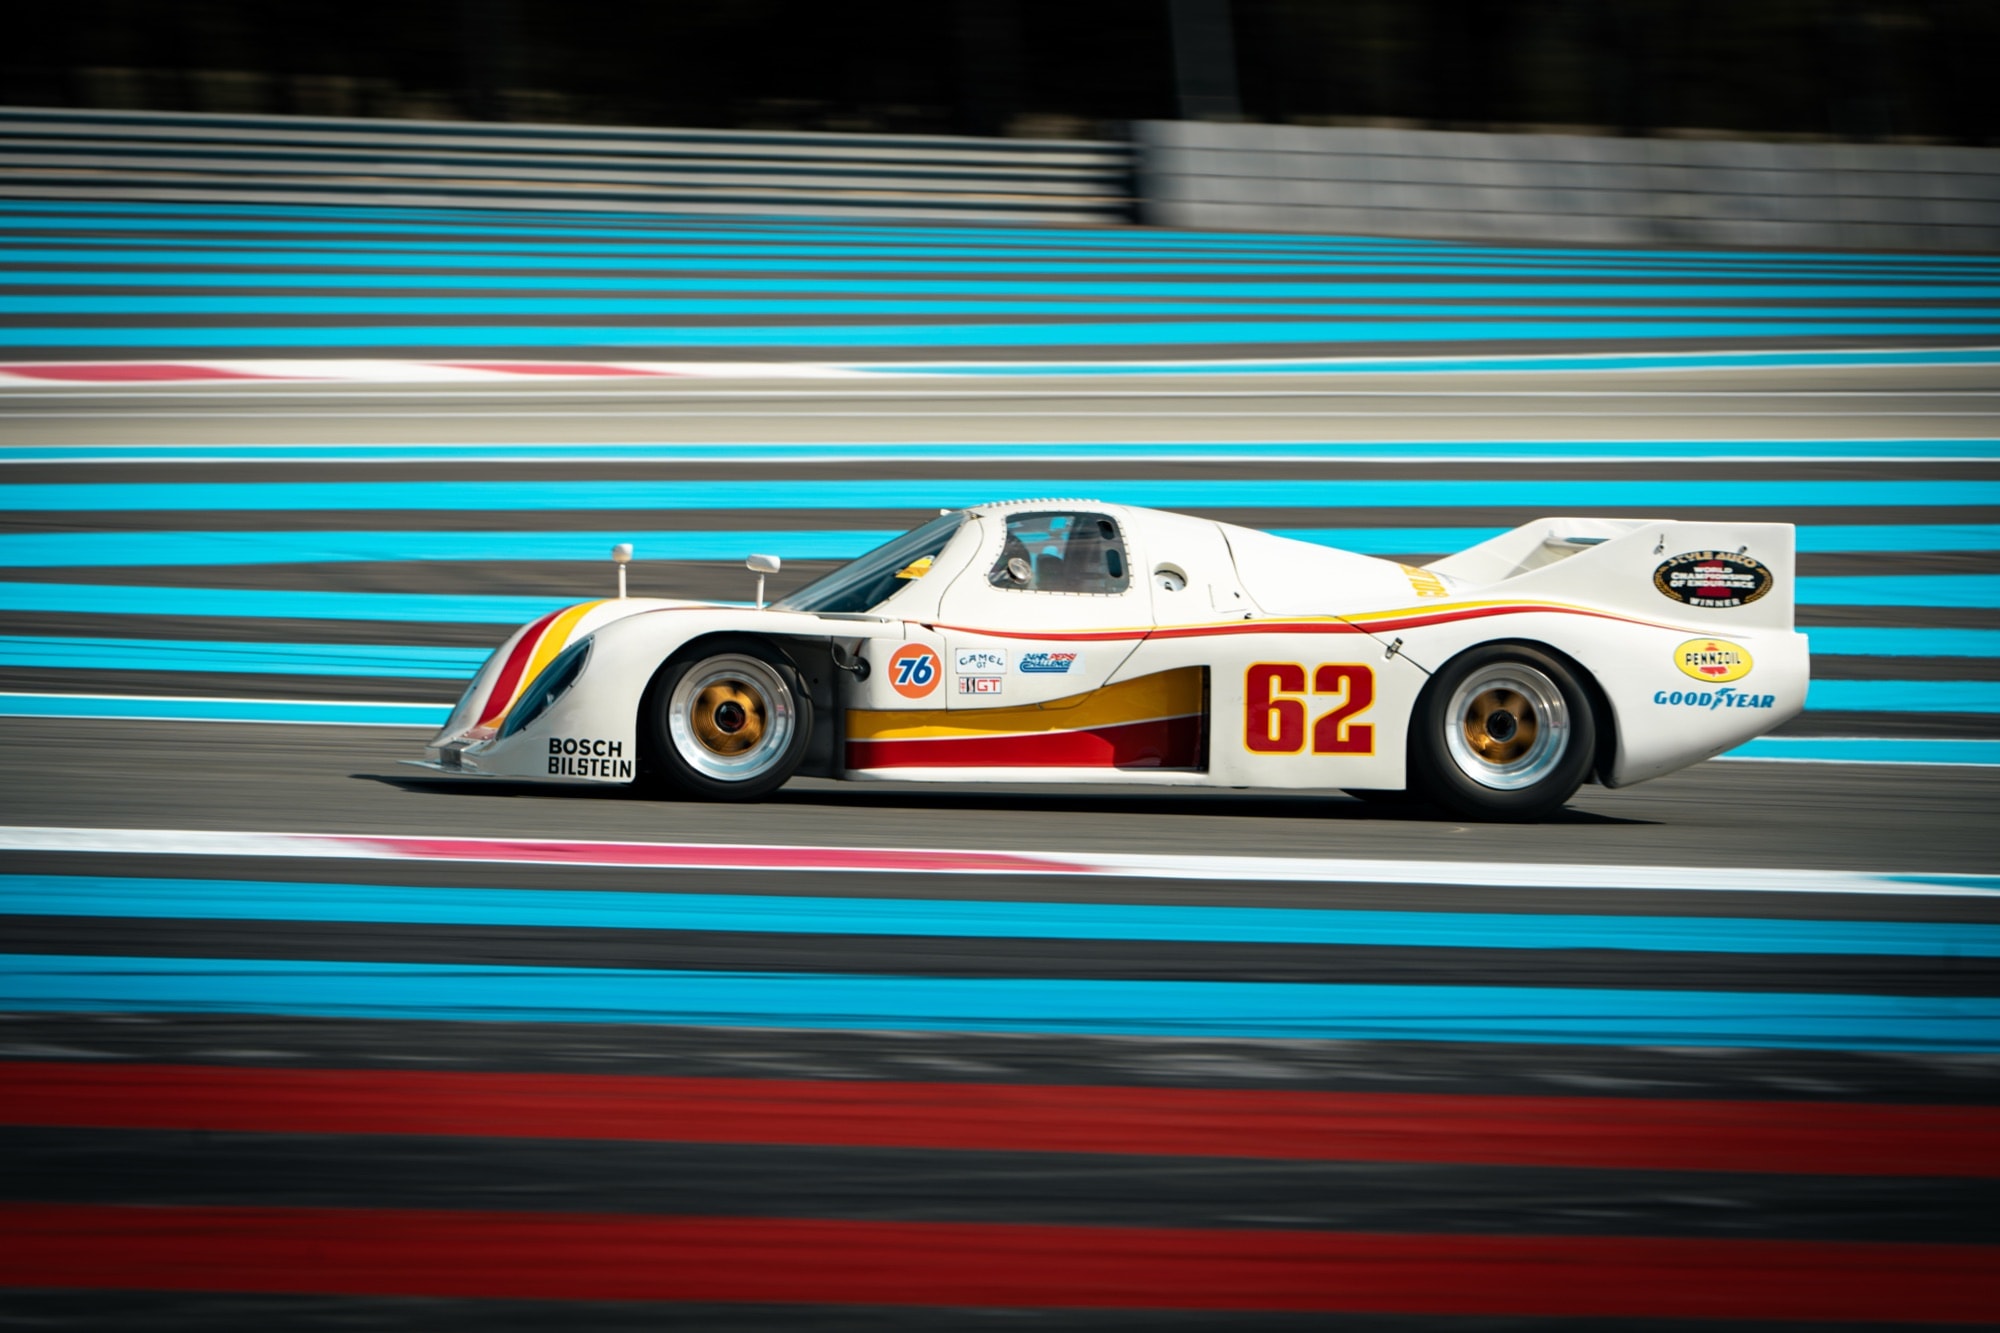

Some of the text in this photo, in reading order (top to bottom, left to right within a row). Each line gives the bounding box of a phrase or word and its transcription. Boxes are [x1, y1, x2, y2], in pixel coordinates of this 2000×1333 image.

[1668, 551, 1757, 569] STYLE AUTO
[1670, 572, 1755, 581] CHAMPIONSHIP
[1693, 566, 1733, 574] WORLD
[1669, 580, 1756, 589] OF ENDURANCE
[1689, 597, 1741, 608] WINNER
[959, 653, 1004, 666] CAMEL
[976, 661, 986, 669] GT
[1685, 651, 1741, 666] PENNZOIL
[895, 654, 934, 687] 76
[977, 679, 1001, 692] GT
[1653, 687, 1776, 711] GOODYEAR
[1243, 661, 1376, 757] 62
[548, 737, 622, 758] BOSCH
[547, 756, 632, 778] BILSTEIN
